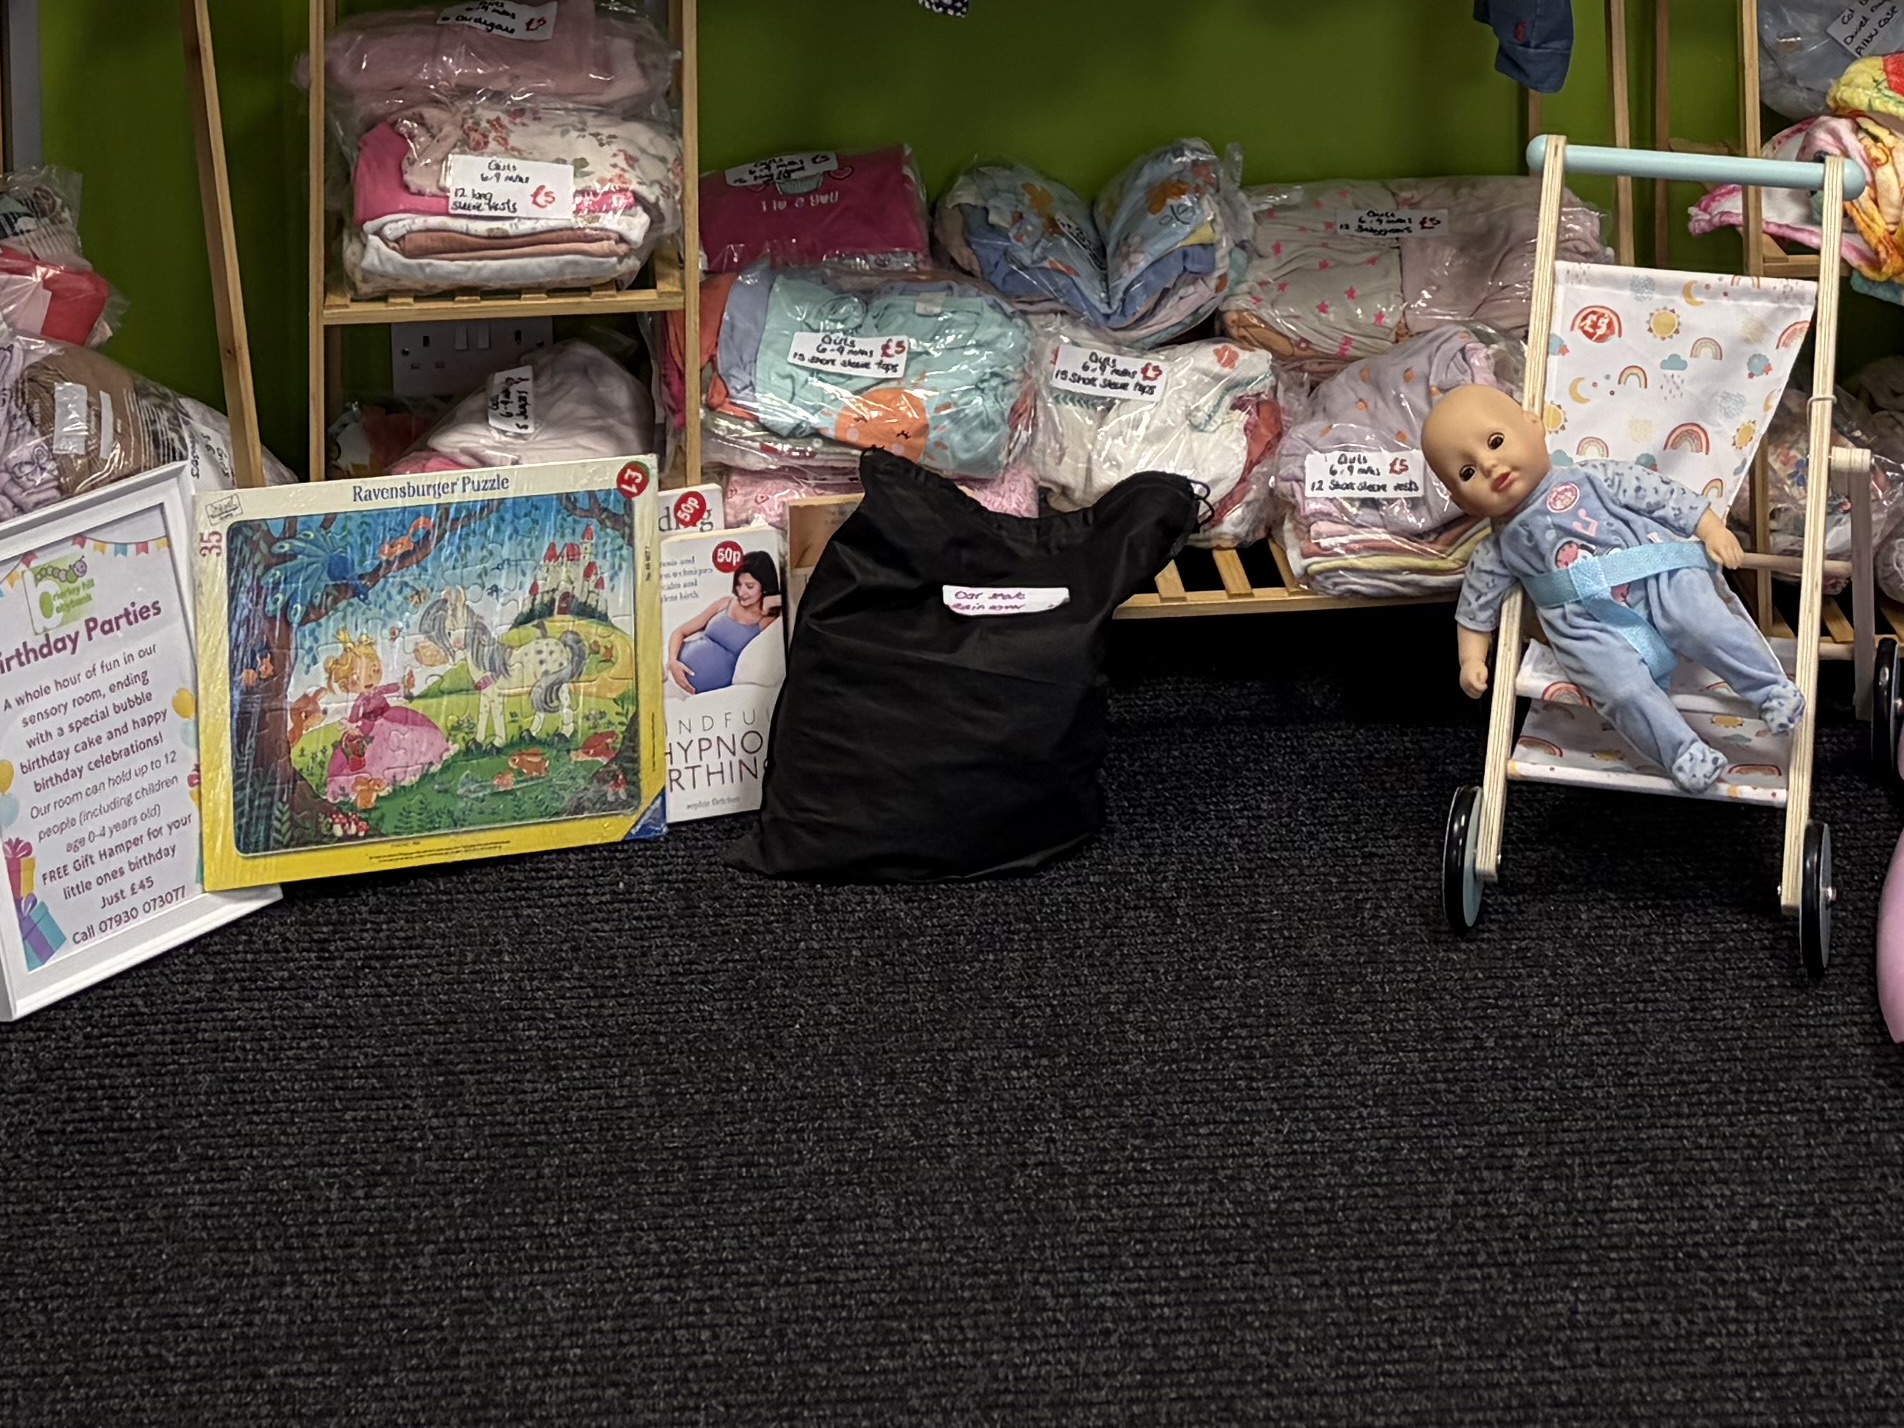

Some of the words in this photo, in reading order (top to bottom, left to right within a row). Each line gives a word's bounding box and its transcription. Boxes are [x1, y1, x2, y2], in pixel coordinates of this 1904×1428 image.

[352, 480, 458, 503] Ravensburger
[461, 473, 510, 494] Puzzle
[200, 530, 223, 558] 35
[716, 547, 742, 564] 50p
[85, 600, 162, 641] Parties
[3, 699, 13, 712] A
[15, 685, 52, 707] whole
[54, 672, 82, 690] hour
[85, 664, 98, 680] of
[101, 658, 121, 675] fun
[123, 652, 135, 664] in
[138, 644, 157, 659] our
[100, 894, 126, 909] Just
[130, 876, 155, 895] £45
[72, 924, 96, 945] Call
[99, 907, 139, 933] 07930
[143, 885, 186, 913] 073077
